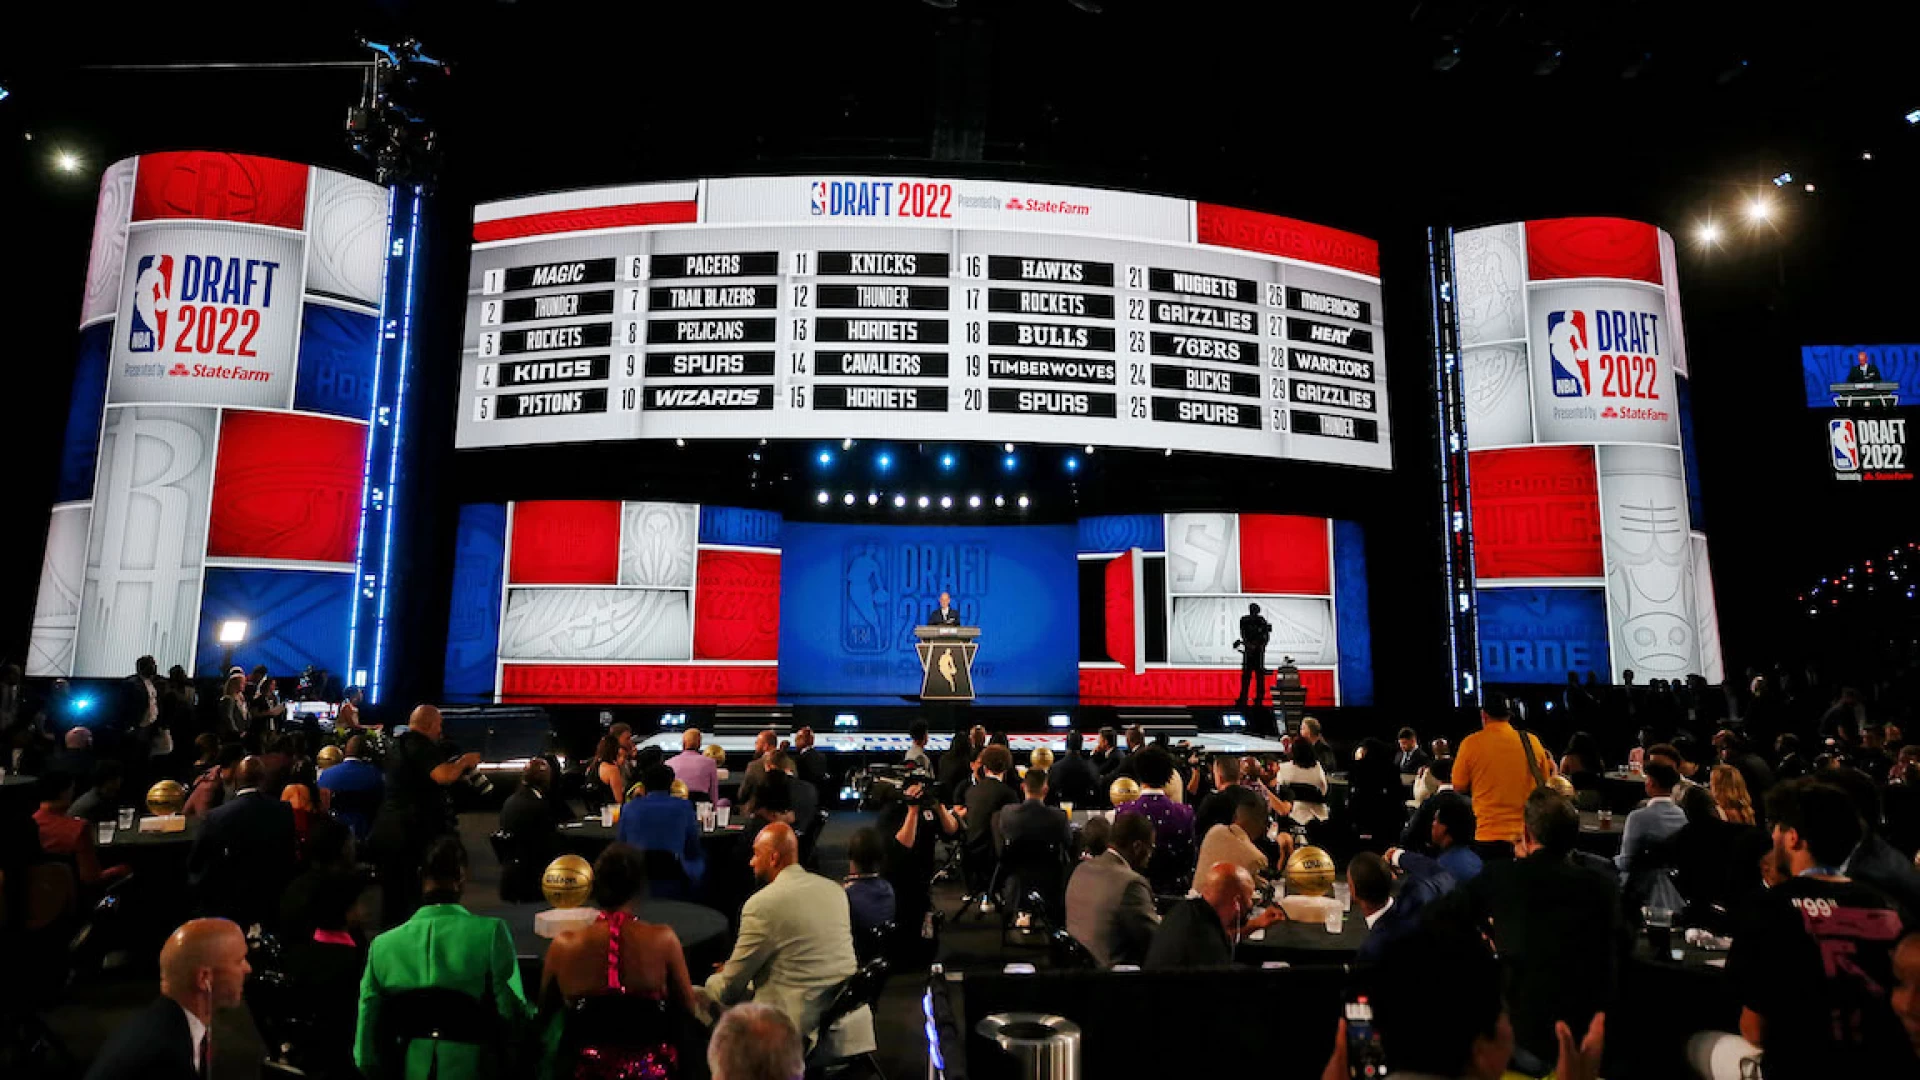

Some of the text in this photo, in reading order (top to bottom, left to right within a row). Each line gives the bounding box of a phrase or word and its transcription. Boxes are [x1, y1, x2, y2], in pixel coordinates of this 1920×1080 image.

[830, 182, 953, 218] DRAFT 2022
[532, 263, 585, 285] MAGIC
[687, 255, 740, 275] PACERS
[796, 253, 916, 274] 11 KNICKS
[966, 256, 1083, 282] 16 HAWKS
[180, 254, 280, 308] DRAFT
[1129, 267, 1237, 298] 21 NUGGETS
[535, 295, 578, 318] THUNDER
[670, 289, 703, 308] TRAIL
[704, 288, 756, 308] BLAZERS
[794, 286, 908, 308] 12 THUNDER
[967, 290, 1084, 314] 17 ROCKETS
[1269, 285, 1283, 306] 26
[1129, 299, 1252, 330] 22 GRIZZLIES
[174, 304, 260, 357] 2022
[527, 327, 582, 350] ROCKETS
[678, 320, 743, 340] PELICANS
[793, 319, 917, 341] 13 HORNETS
[965, 322, 1088, 347] 18 BULLS
[1270, 316, 1354, 345] 27 HEAT
[1595, 309, 1659, 355] DRAFT
[1129, 332, 1240, 360] 23 76ERS
[514, 360, 590, 382] KINGS
[674, 355, 743, 373] SPURS
[792, 353, 920, 375] 14 CAVALIERS
[965, 355, 1114, 380] 19 TIMBERWOLVES
[1271, 347, 1370, 378] 28 WARRIORS
[1130, 364, 1230, 392] 24 BUCKS
[1556, 379, 1577, 394] NBA
[1600, 354, 1659, 400] 2022
[518, 392, 582, 415] PISTONS
[622, 388, 760, 411] 10 WIZARDS
[791, 386, 917, 409] 15 HORNETS
[964, 388, 1088, 413] 20 SPURS
[1272, 378, 1371, 408] 29 GRIZZLIES
[1131, 396, 1238, 423] 25 SPURS
[1273, 410, 1287, 431] 30
[1857, 420, 1905, 443] DRAFT
[1861, 444, 1905, 468] 2022
[900, 543, 987, 596] DRAFT
